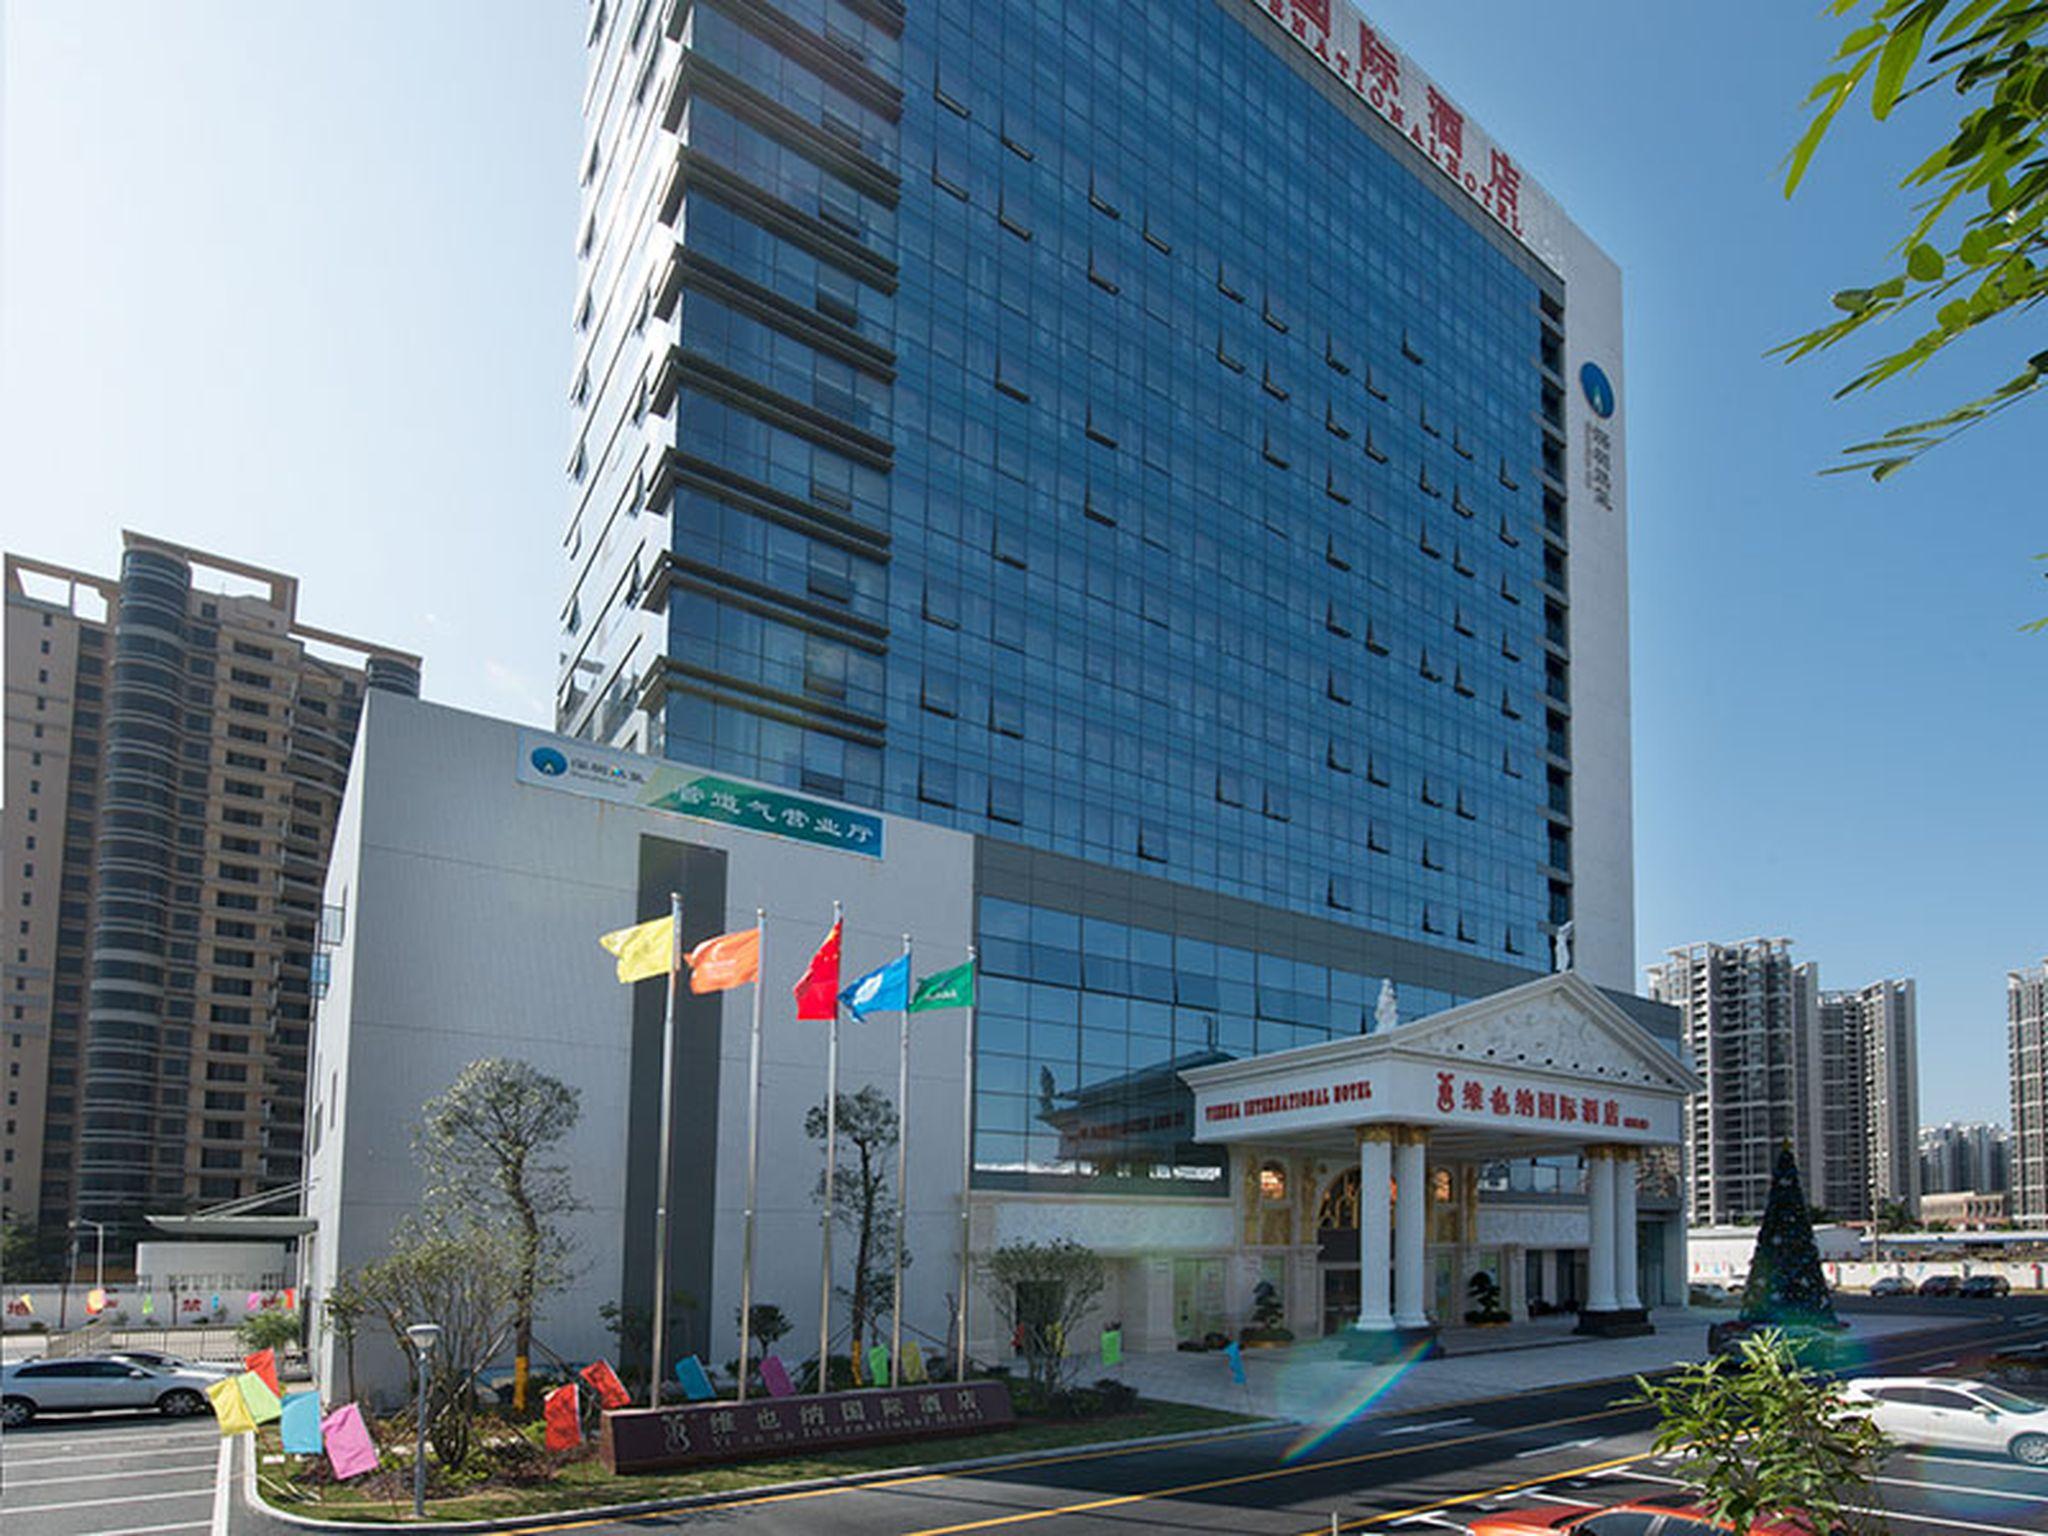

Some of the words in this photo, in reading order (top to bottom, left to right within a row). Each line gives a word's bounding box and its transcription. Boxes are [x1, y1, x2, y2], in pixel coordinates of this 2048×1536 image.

[1333, 1079, 1373, 1104] HOTEL
[1461, 1080, 1620, 1127] 维也纳国际酒店
[709, 1389, 976, 1434] 维也纳国际酒店
